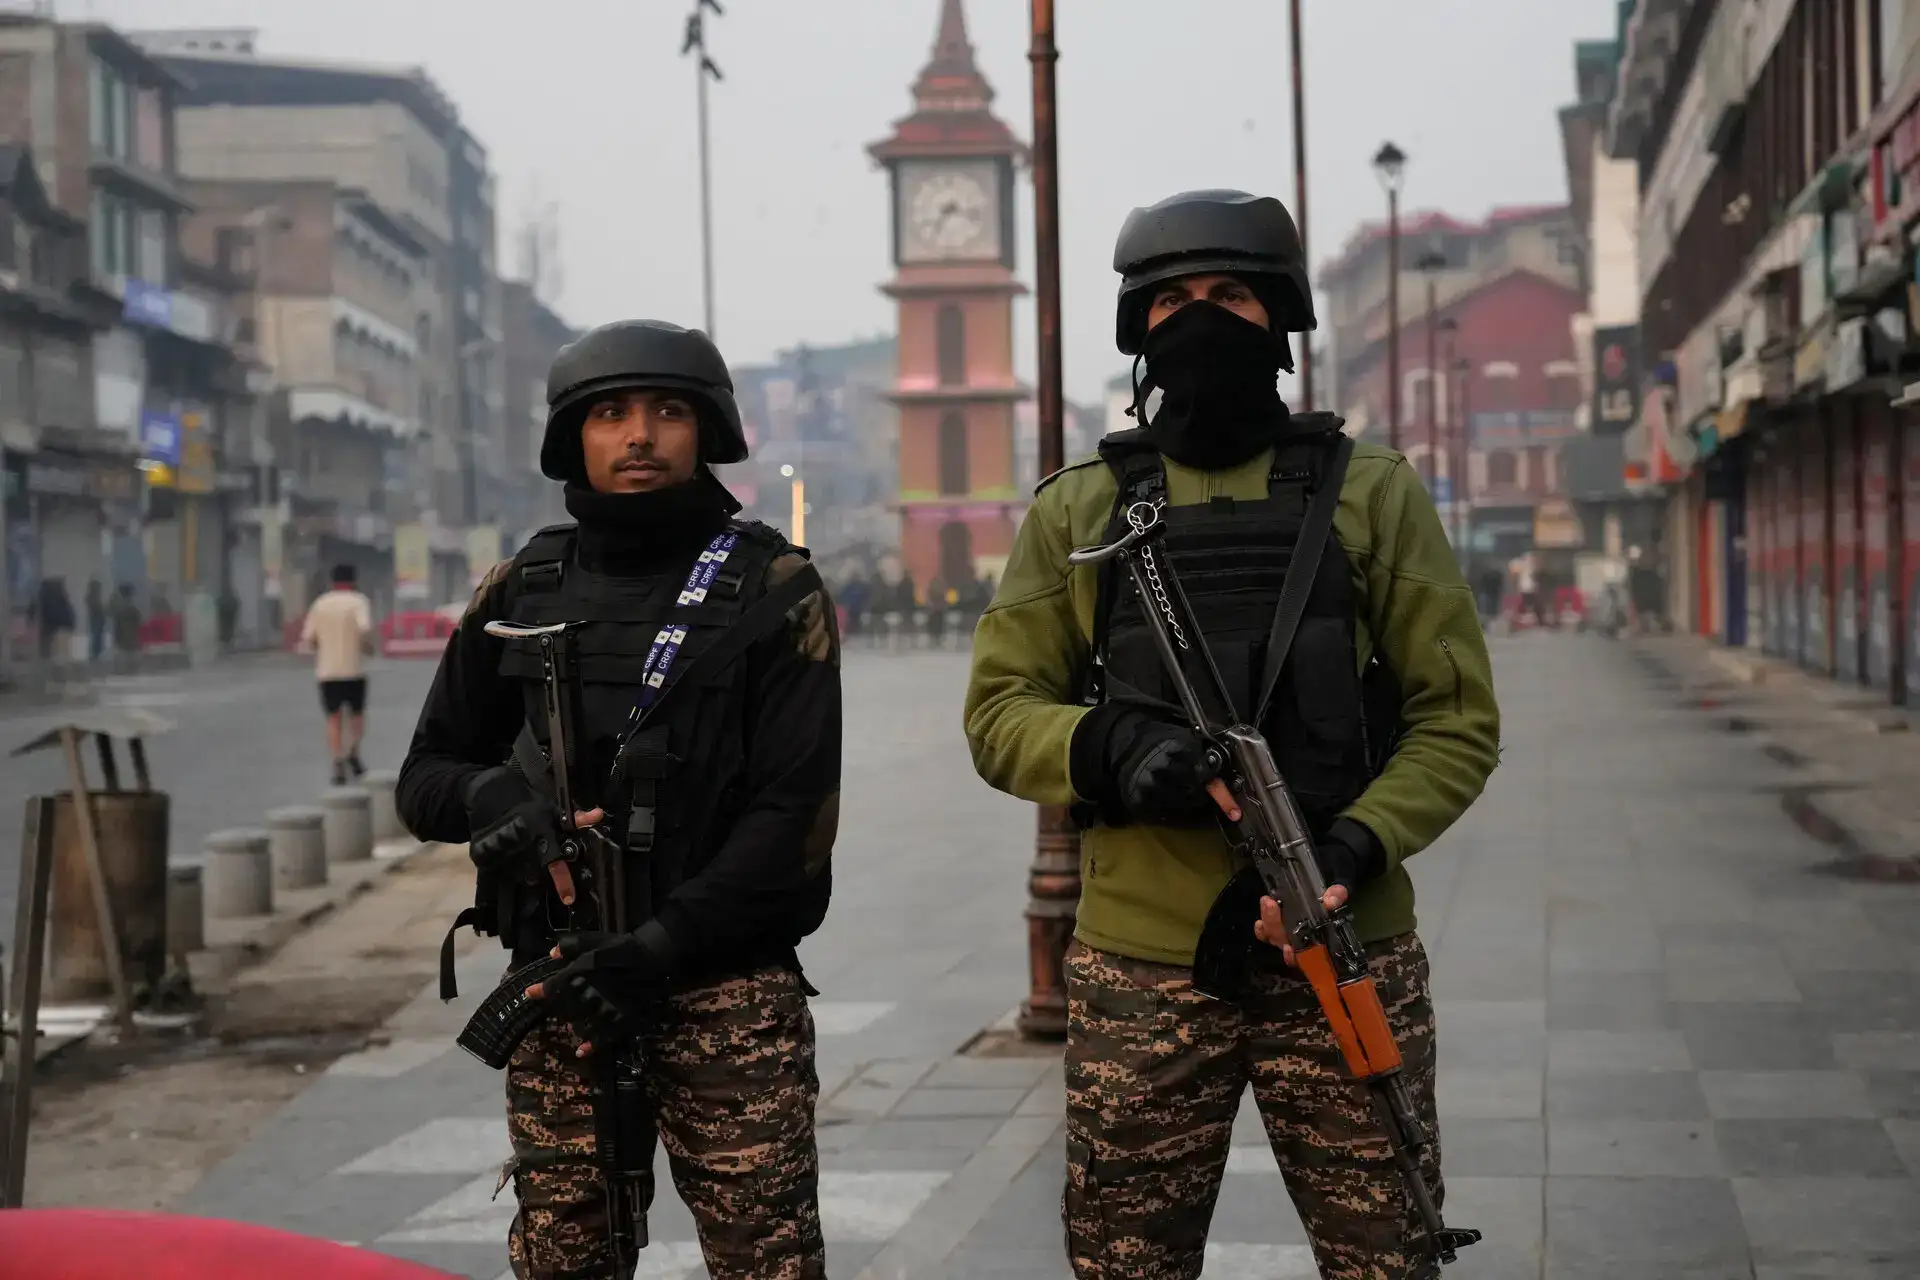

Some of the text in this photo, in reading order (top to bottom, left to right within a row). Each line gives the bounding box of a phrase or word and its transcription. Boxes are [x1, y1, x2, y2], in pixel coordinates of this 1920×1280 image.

[710, 534, 726, 549] CRPF
[687, 565, 702, 588] CRPF
[700, 563, 716, 584] CRPF
[644, 647, 658, 669] CRPF
[658, 646, 674, 669] CRPF
